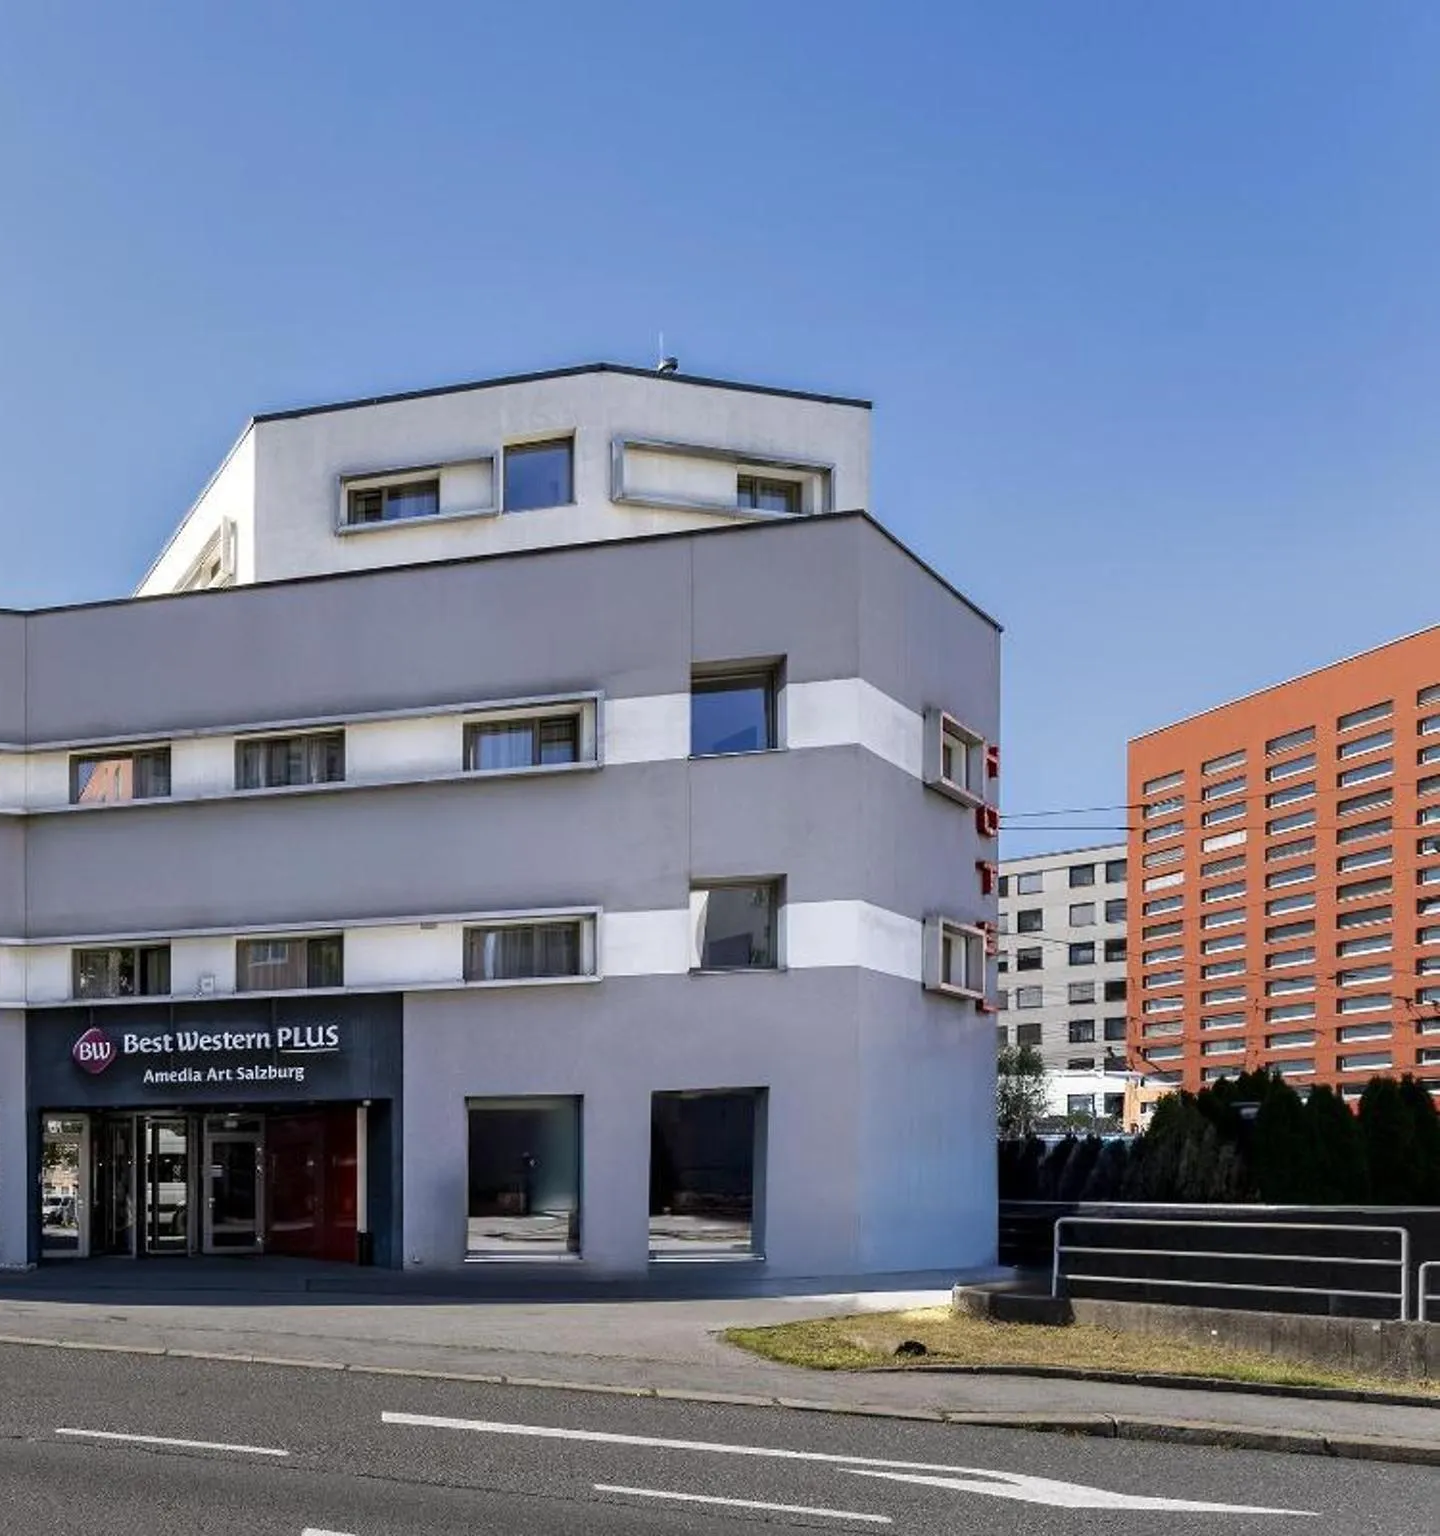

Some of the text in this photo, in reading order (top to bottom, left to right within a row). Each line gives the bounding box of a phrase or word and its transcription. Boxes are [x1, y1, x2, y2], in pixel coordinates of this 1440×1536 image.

[123, 1025, 339, 1054] Best Western PLUS
[79, 1041, 111, 1061] BW
[143, 1065, 305, 1083] Amedia Art Salzburg
